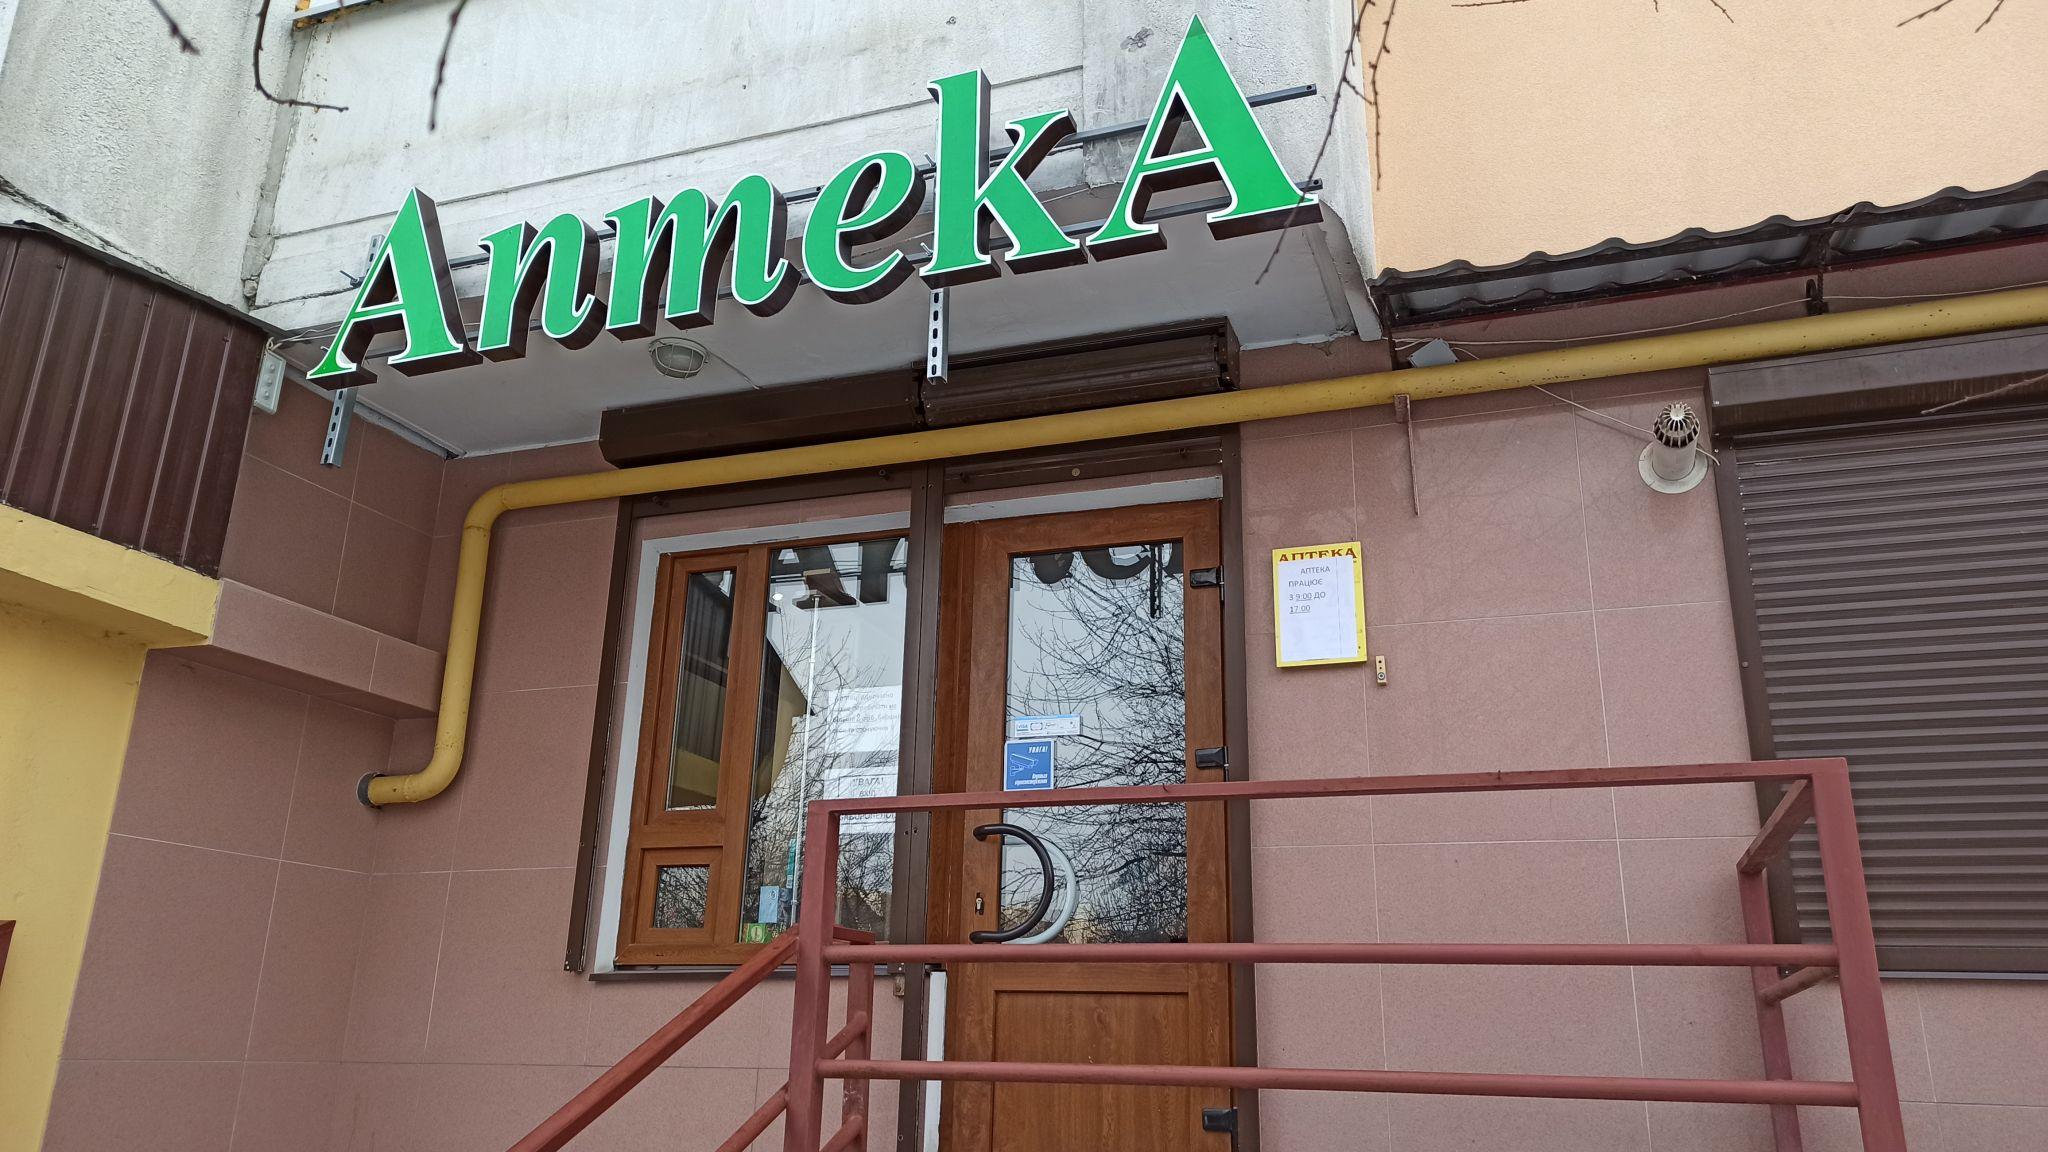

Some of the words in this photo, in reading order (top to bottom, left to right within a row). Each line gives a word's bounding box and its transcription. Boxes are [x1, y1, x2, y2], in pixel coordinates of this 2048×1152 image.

[1279, 547, 1357, 562] АПТЕКА
[1300, 566, 1330, 575] АПТЕКА
[1288, 578, 1323, 587] ПРАЦЮЄ
[1313, 591, 1326, 600] ДО
